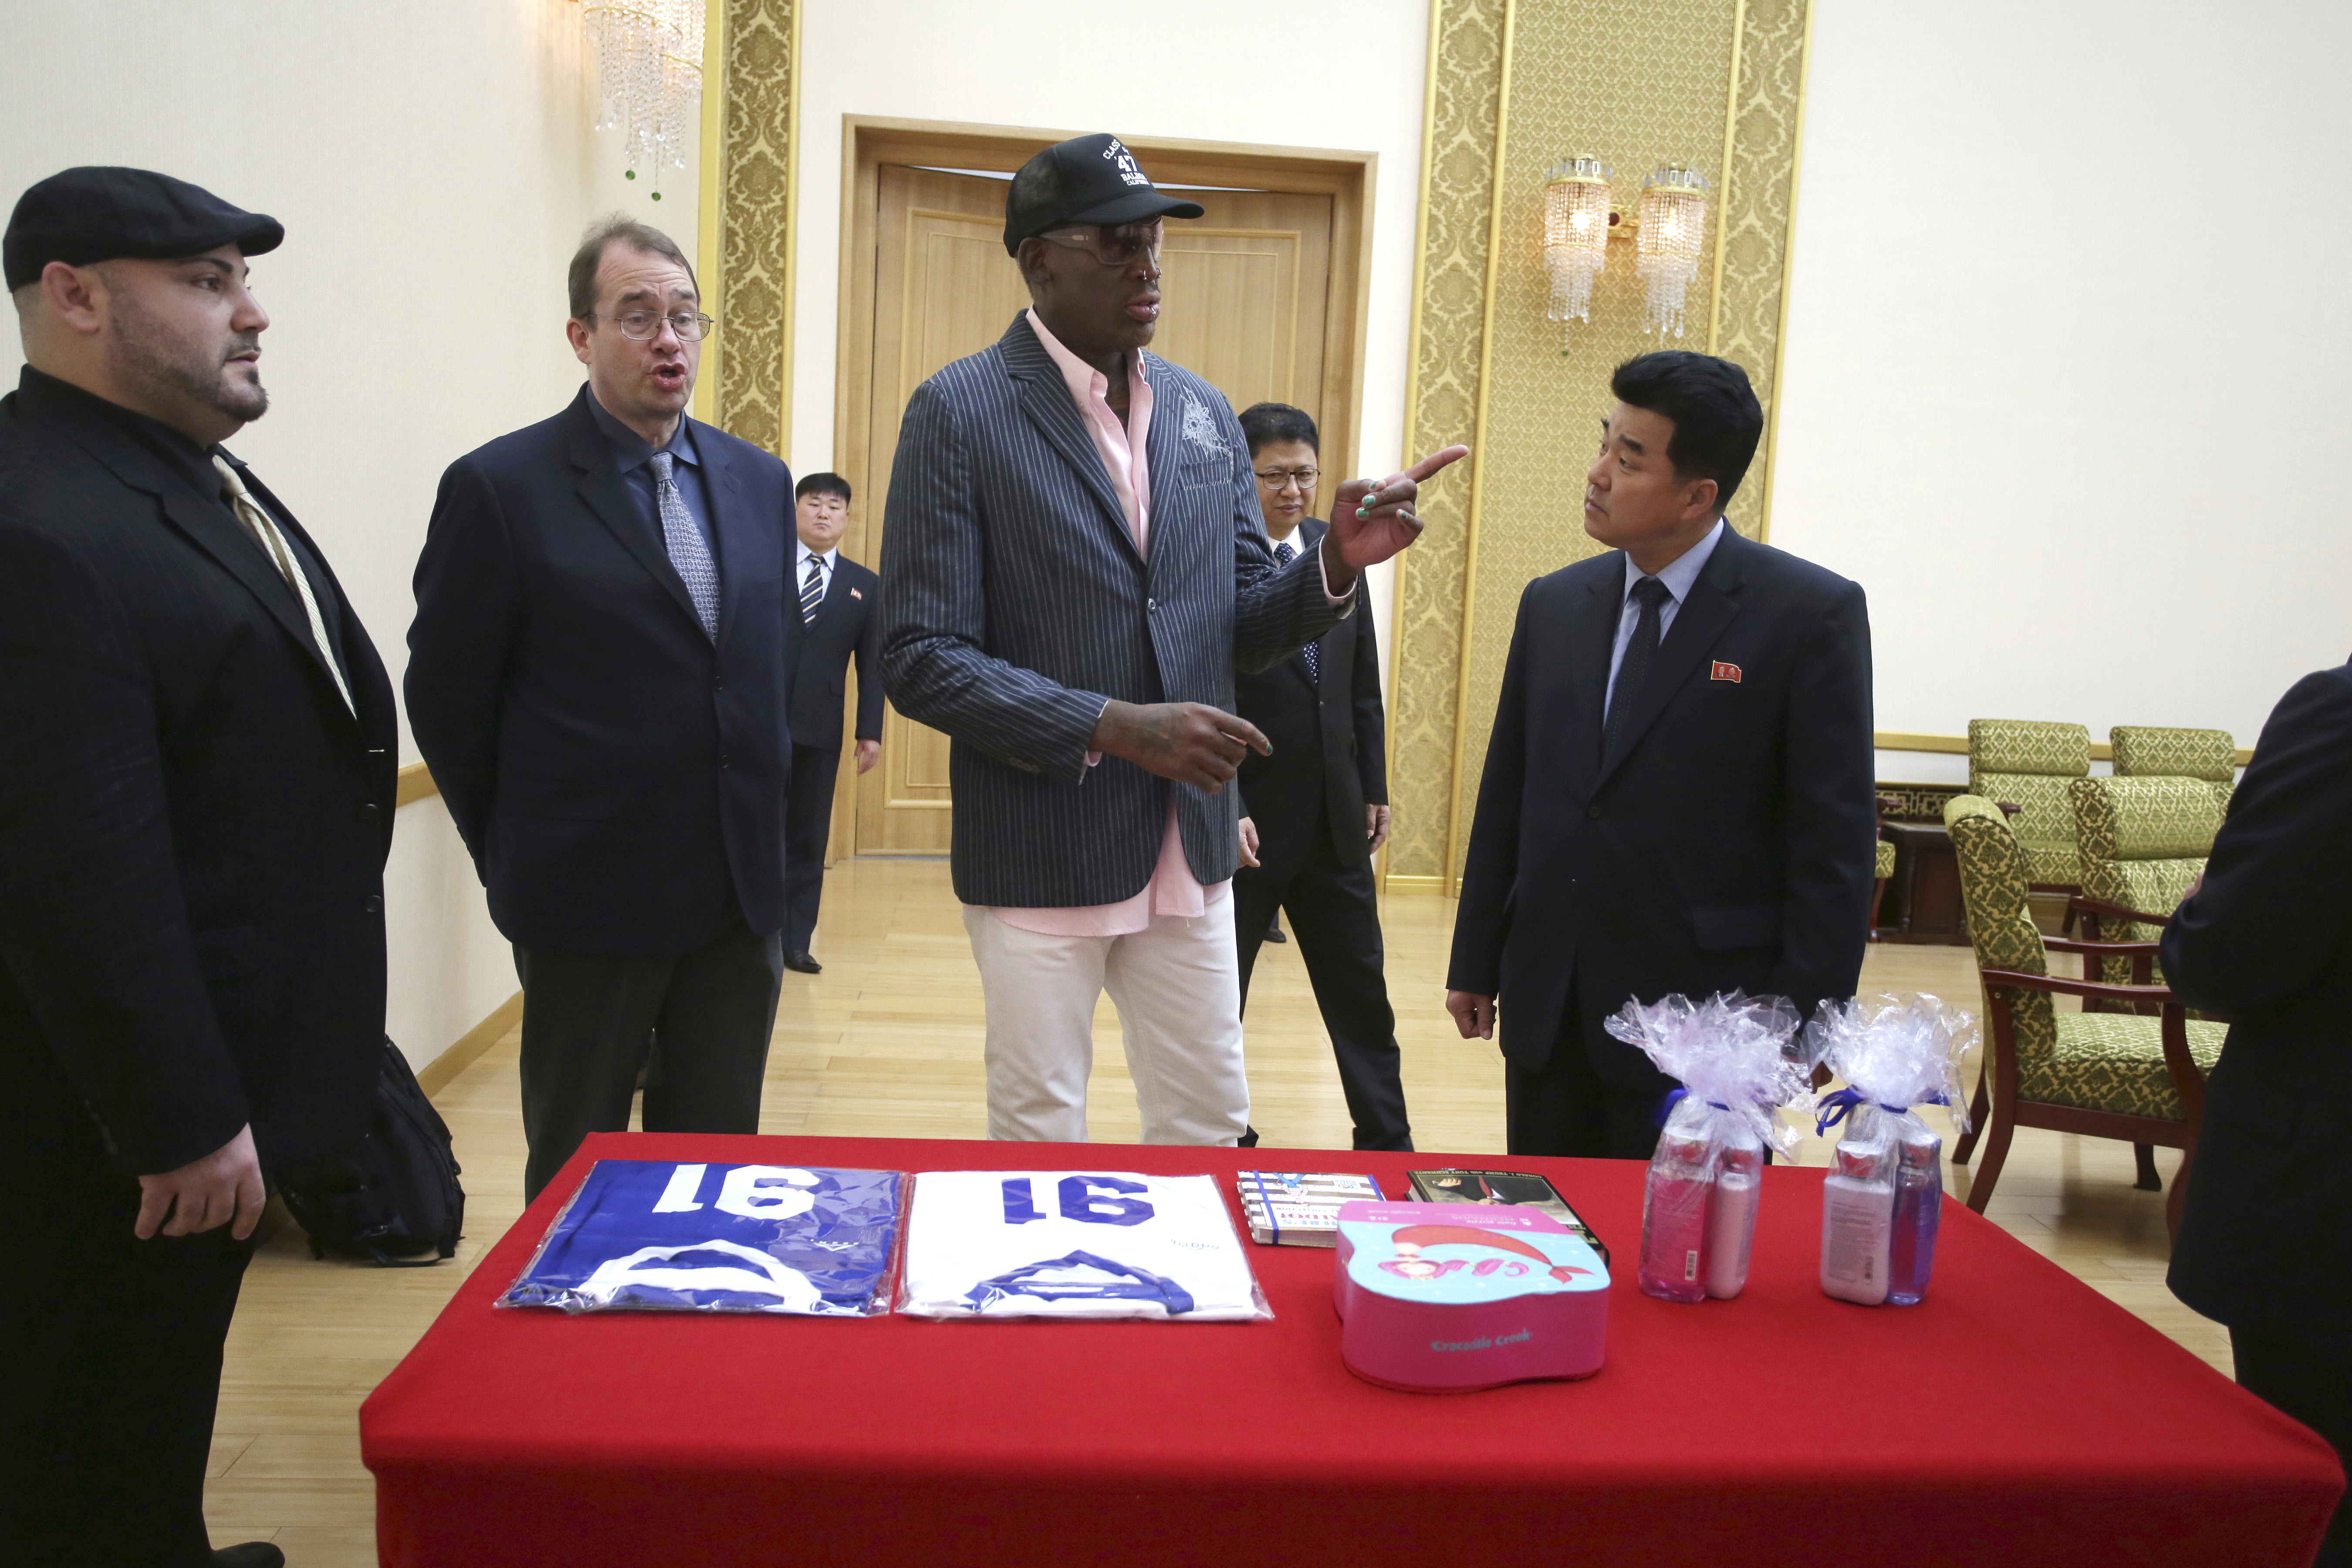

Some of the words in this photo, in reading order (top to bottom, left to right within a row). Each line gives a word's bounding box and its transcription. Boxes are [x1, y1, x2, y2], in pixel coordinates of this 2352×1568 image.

[1102, 139, 1121, 159] CLASS
[1120, 172, 1148, 182] BALBOA
[1431, 1335, 1493, 1352] Crocodile
[1495, 1327, 1530, 1346] Creek
